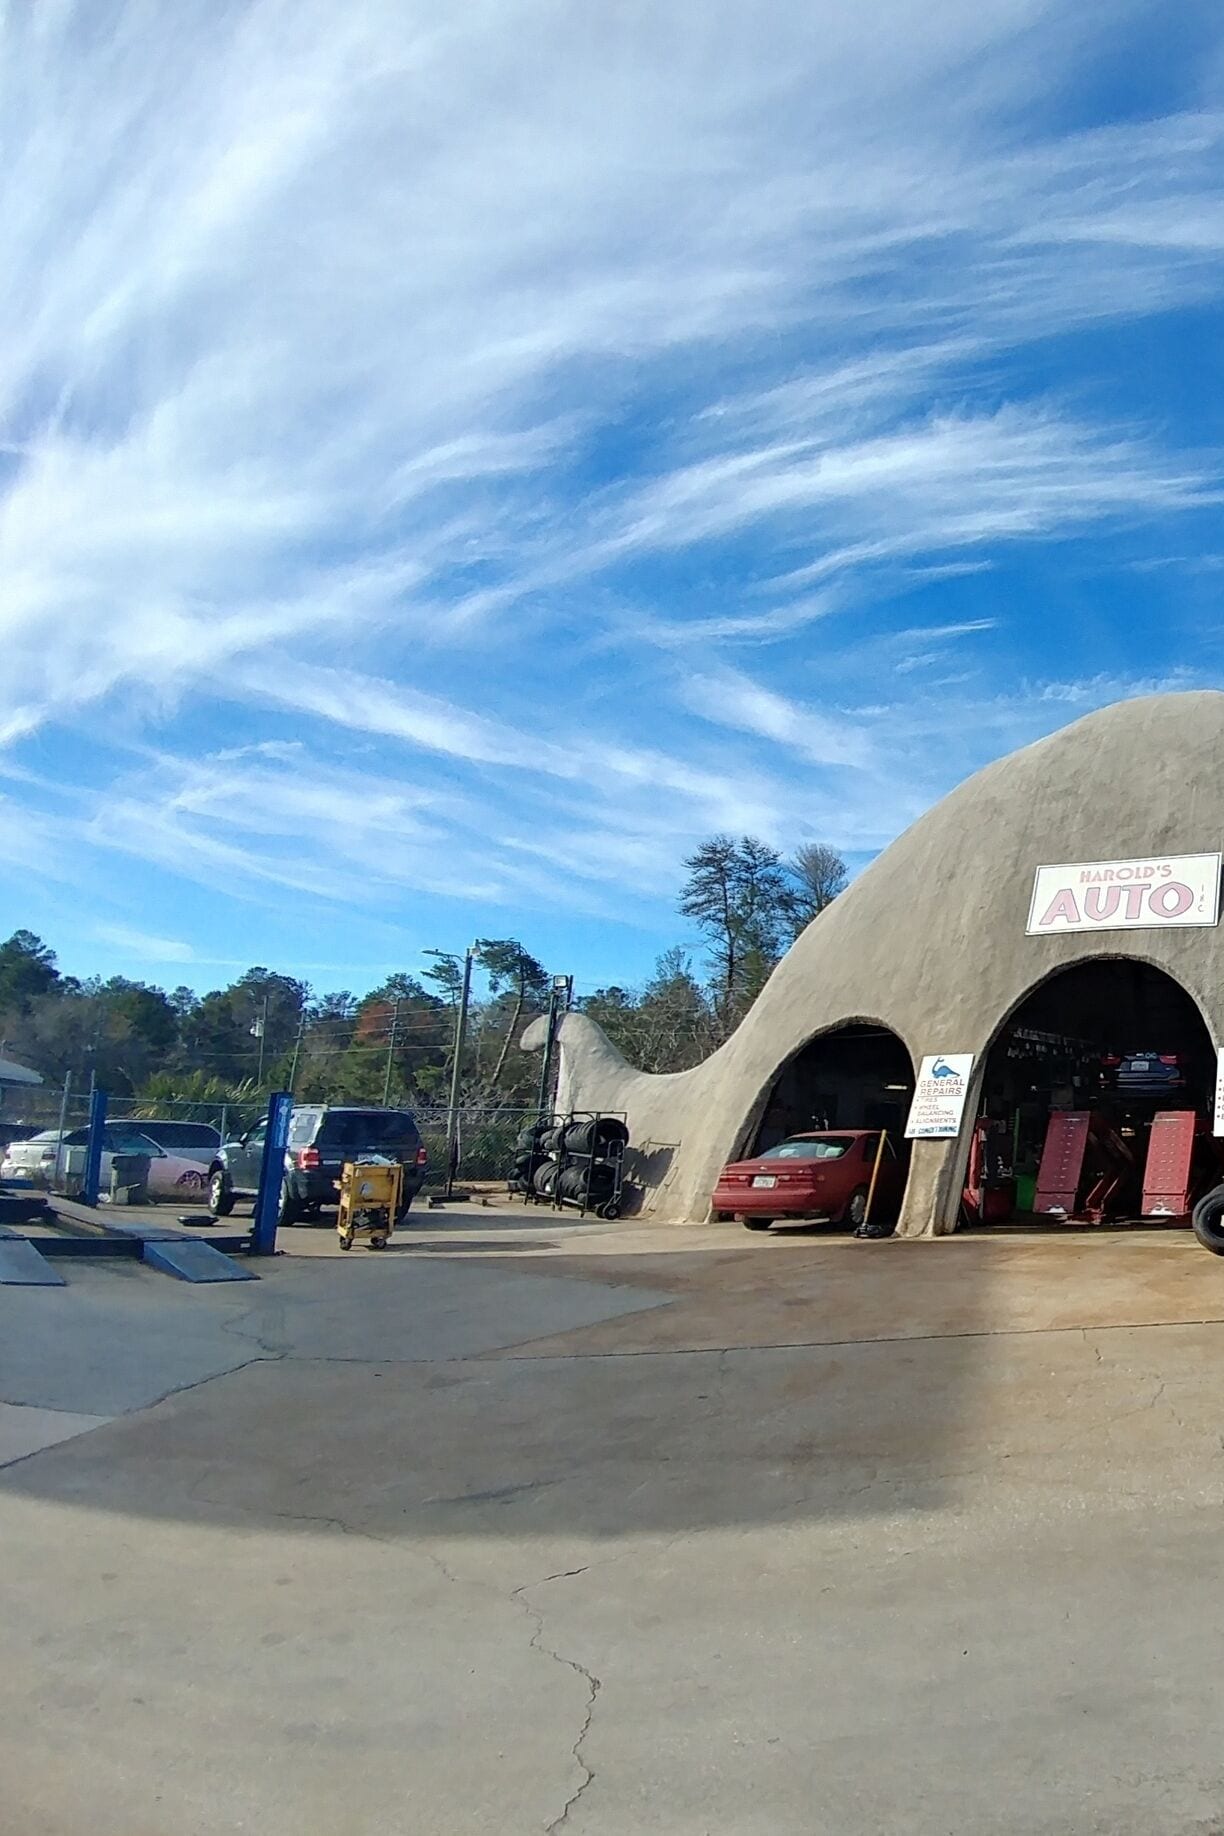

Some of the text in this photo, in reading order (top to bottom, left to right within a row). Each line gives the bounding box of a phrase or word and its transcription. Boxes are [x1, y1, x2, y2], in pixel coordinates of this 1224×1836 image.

[1079, 864, 1173, 883] HAROLD'S
[1039, 881, 1194, 926] AUTO
[920, 1079, 965, 1088] GENERAL
